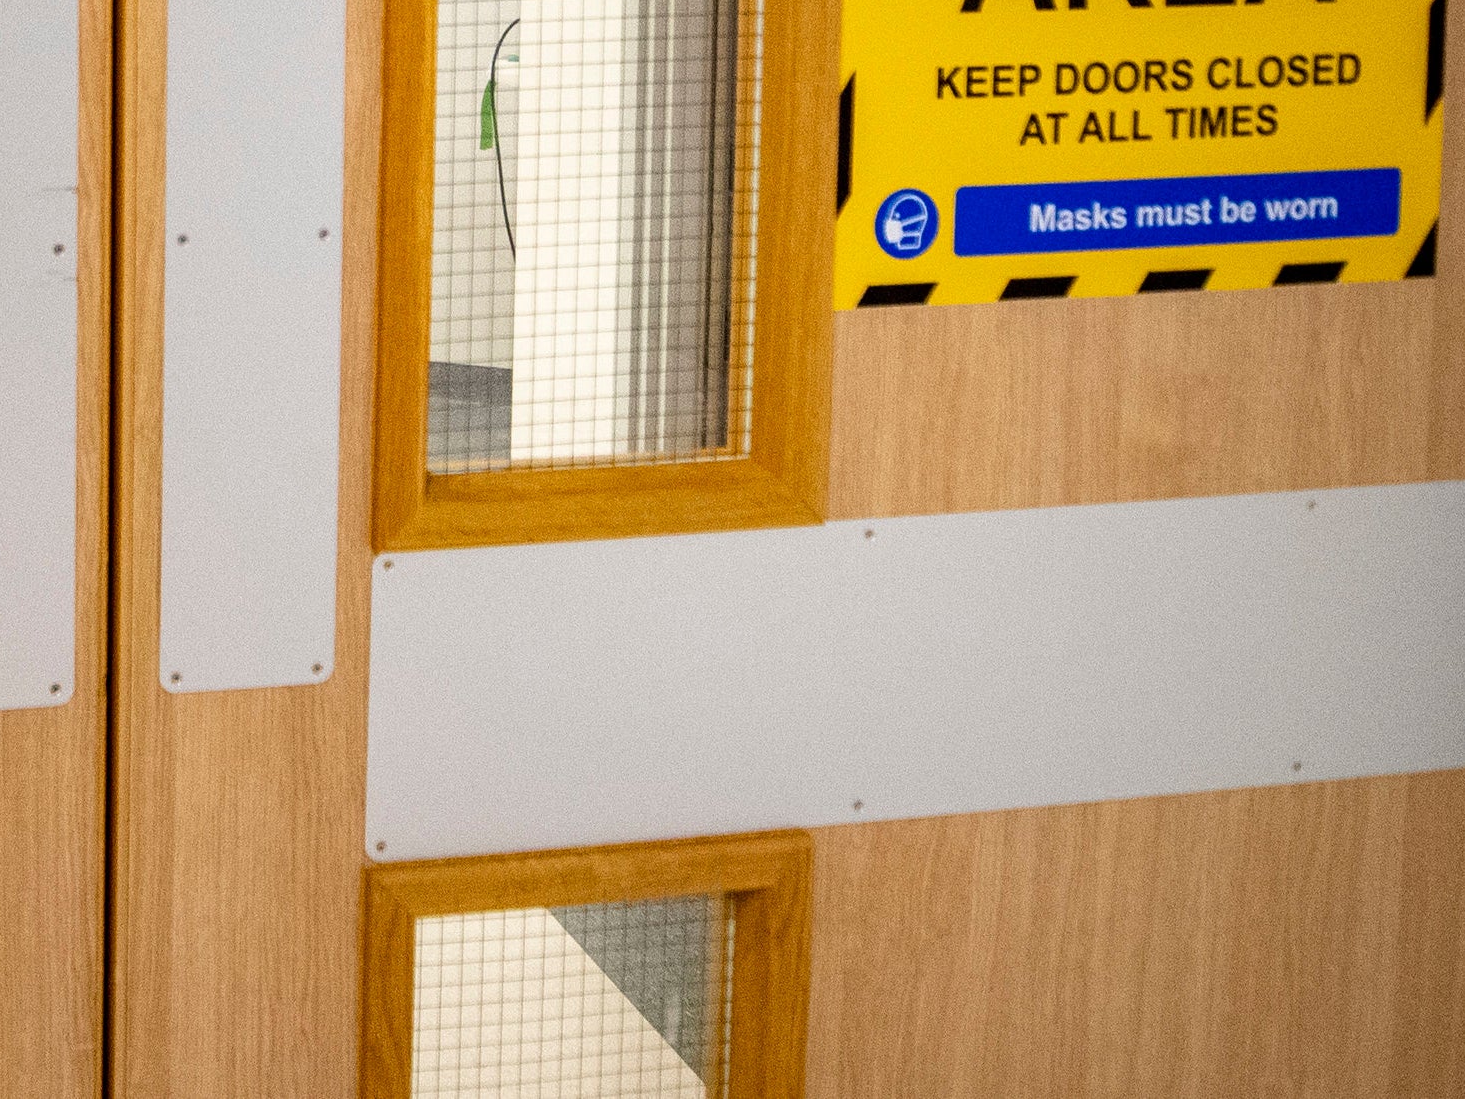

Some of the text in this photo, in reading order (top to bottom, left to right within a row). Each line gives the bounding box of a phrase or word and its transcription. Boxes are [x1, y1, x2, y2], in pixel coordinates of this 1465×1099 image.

[936, 53, 1362, 99] KEEP DOORS CLOSED
[1020, 104, 1278, 146] AT ALL TIMES
[1030, 195, 1339, 233] Masks must be worn
